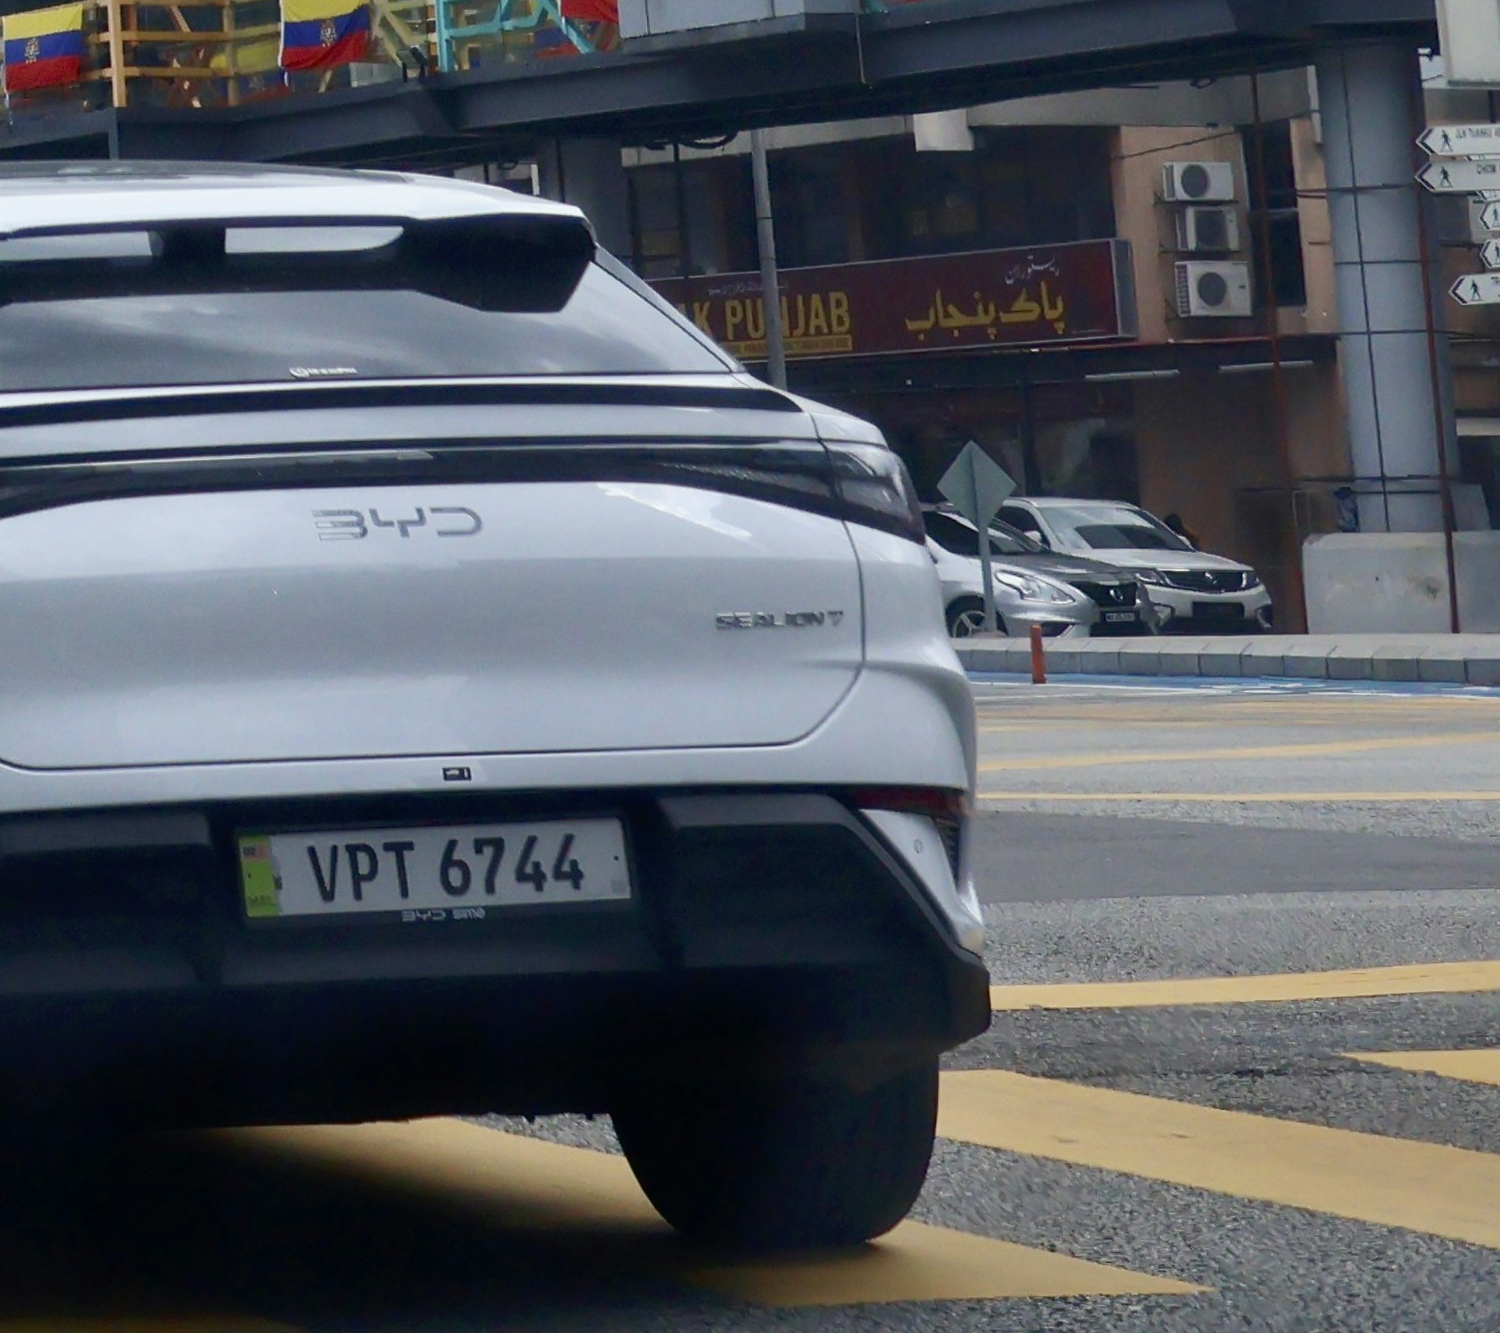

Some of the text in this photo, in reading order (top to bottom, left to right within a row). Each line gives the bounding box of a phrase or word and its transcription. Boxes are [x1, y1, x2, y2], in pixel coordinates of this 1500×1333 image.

[312, 507, 483, 540] BYD
[716, 610, 843, 630] SEALION 7
[307, 833, 584, 903] VPT 6744
